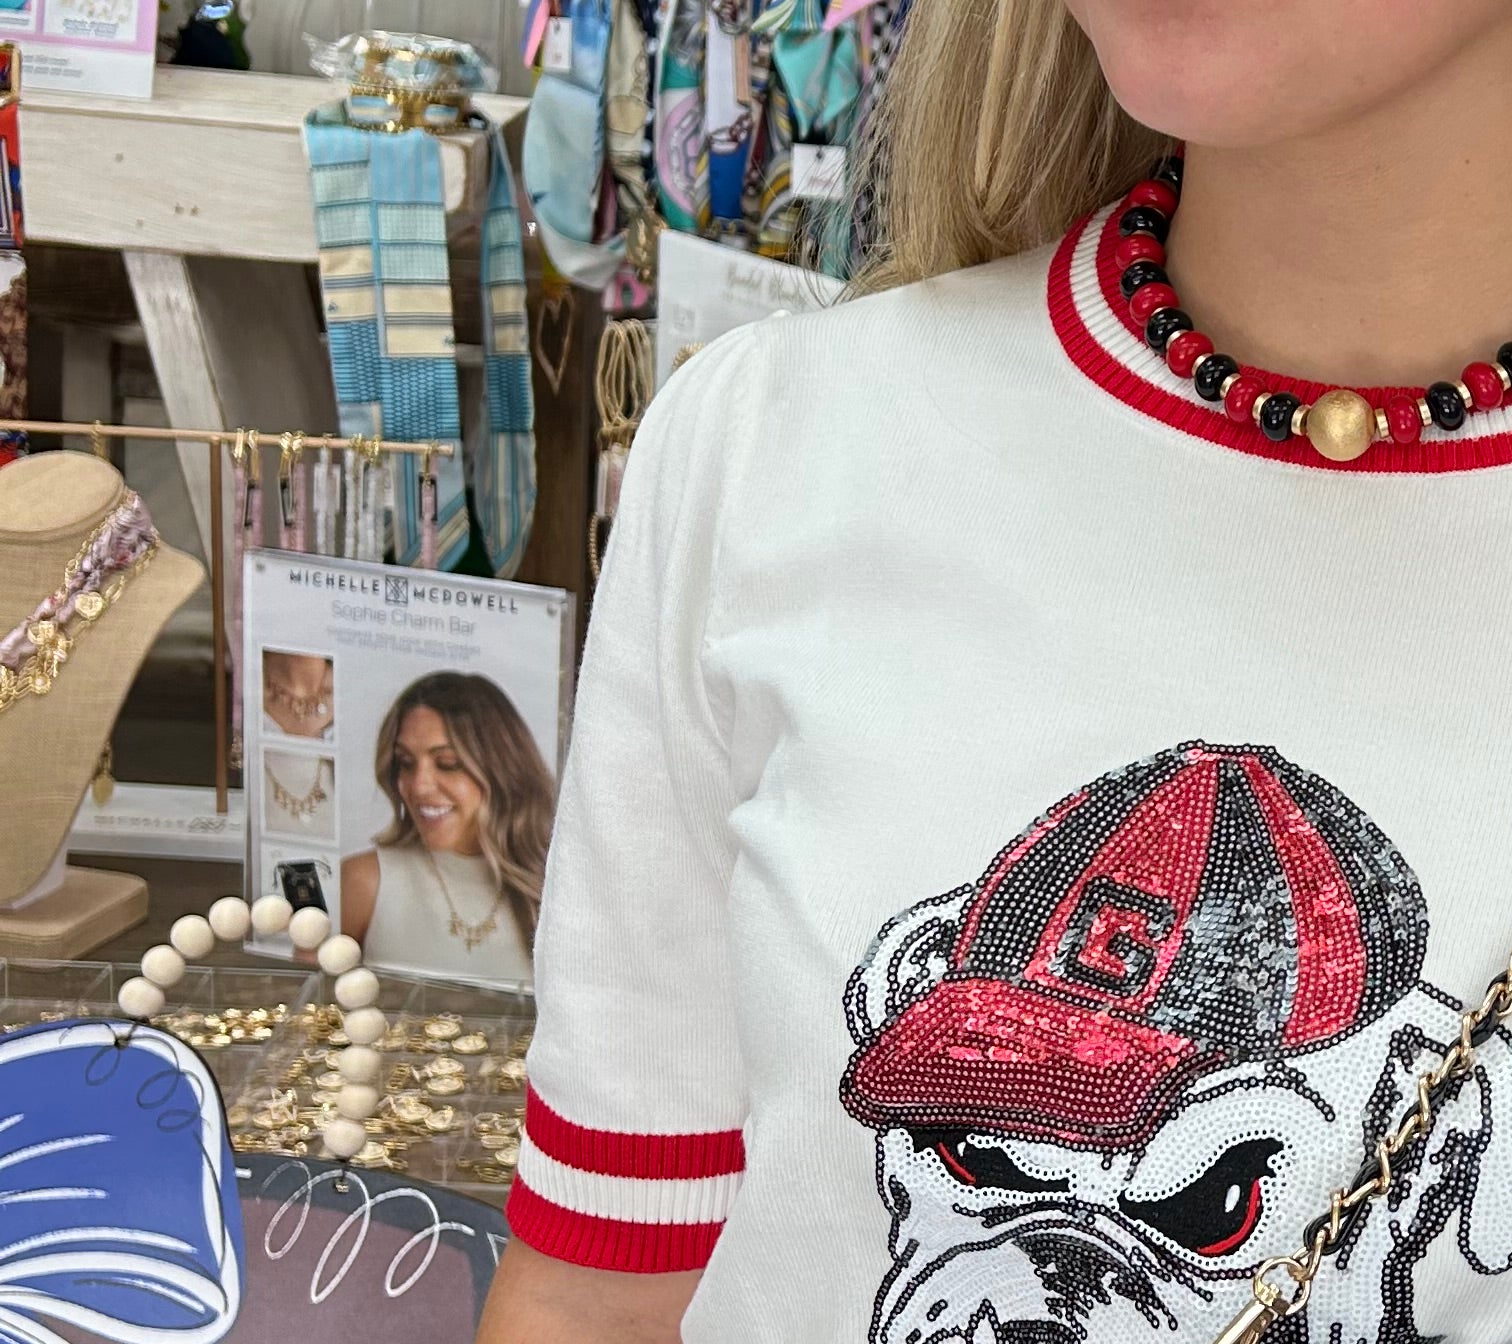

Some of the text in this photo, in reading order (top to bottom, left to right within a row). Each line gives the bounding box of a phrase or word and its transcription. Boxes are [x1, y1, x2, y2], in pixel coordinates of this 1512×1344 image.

[289, 568, 519, 614] MICHELLE MCDOWELL
[331, 599, 476, 636] Sophie Charm Bar
[1048, 875, 1179, 999] G
